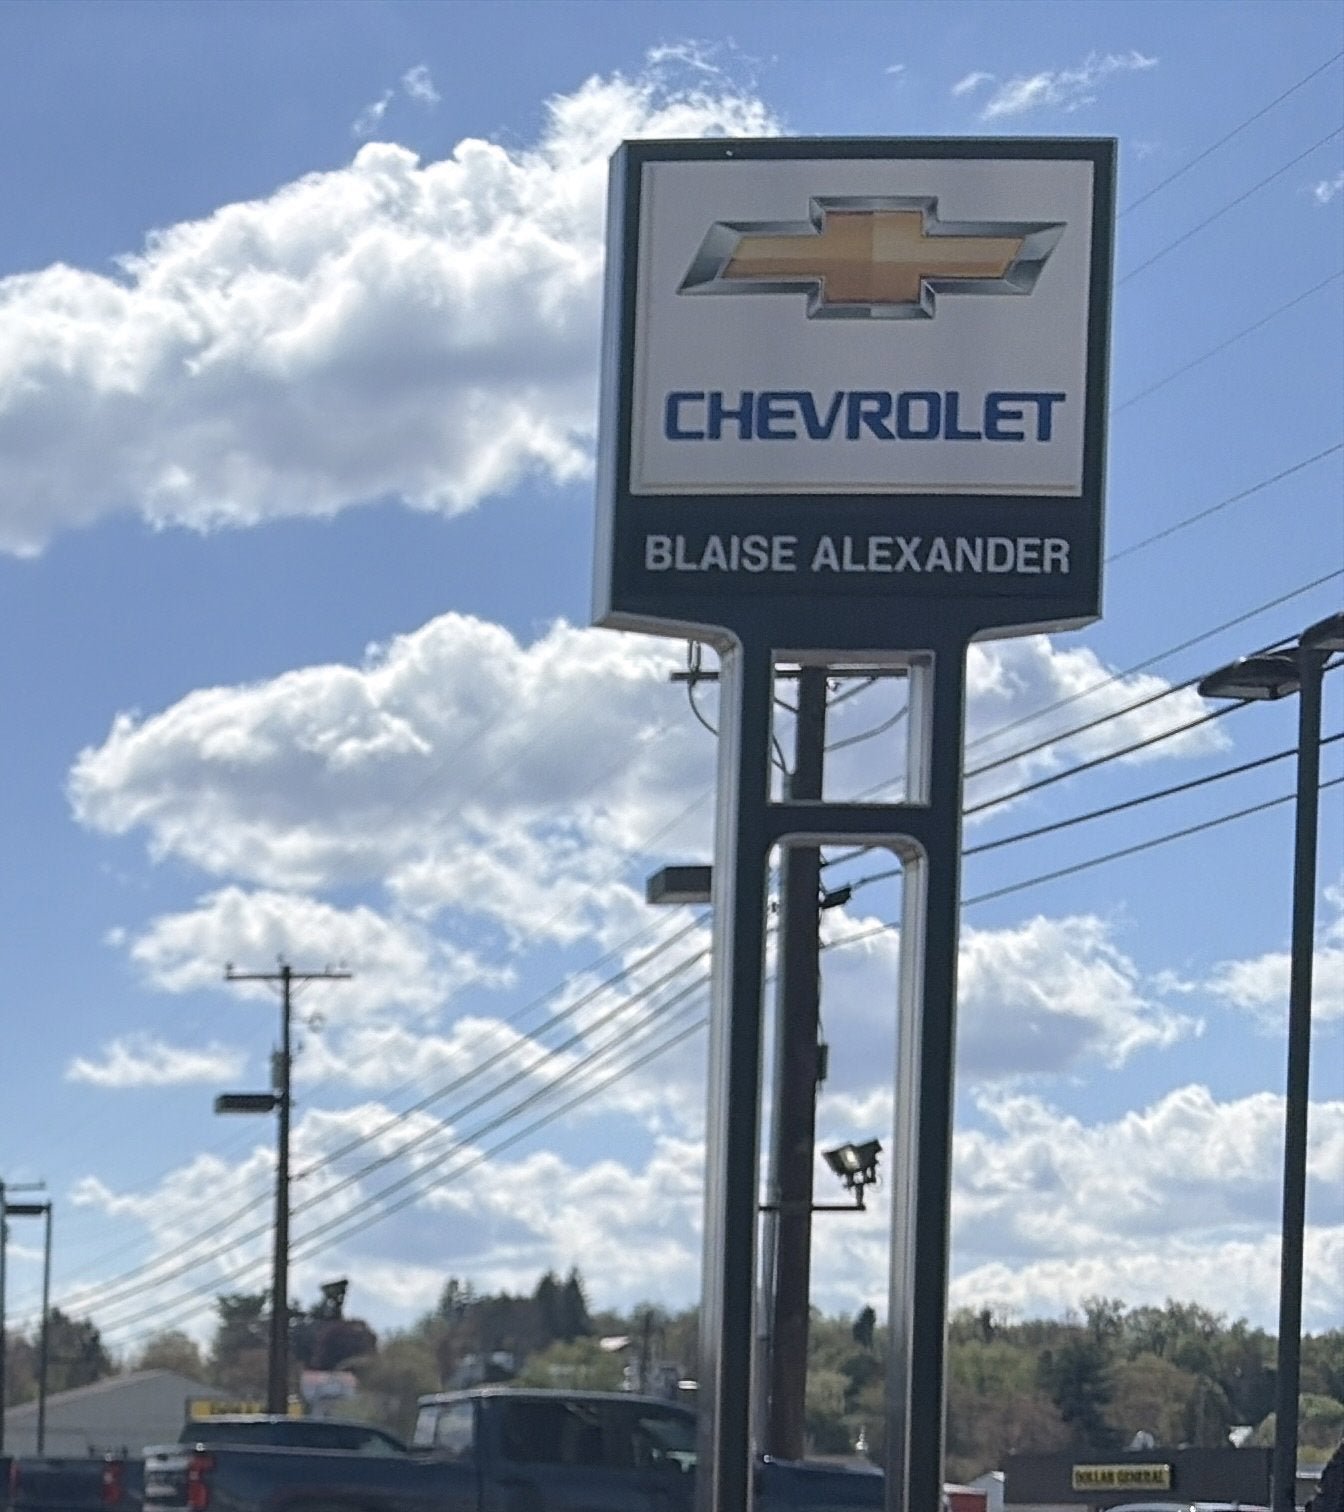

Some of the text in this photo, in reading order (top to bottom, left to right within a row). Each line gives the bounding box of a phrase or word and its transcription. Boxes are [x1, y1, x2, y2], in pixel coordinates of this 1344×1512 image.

[665, 390, 1067, 441] CHEVROLET
[645, 534, 1071, 574] BLAISE ALEXANDER
[1075, 1470, 1164, 1484] DOLLAR GENERAL
